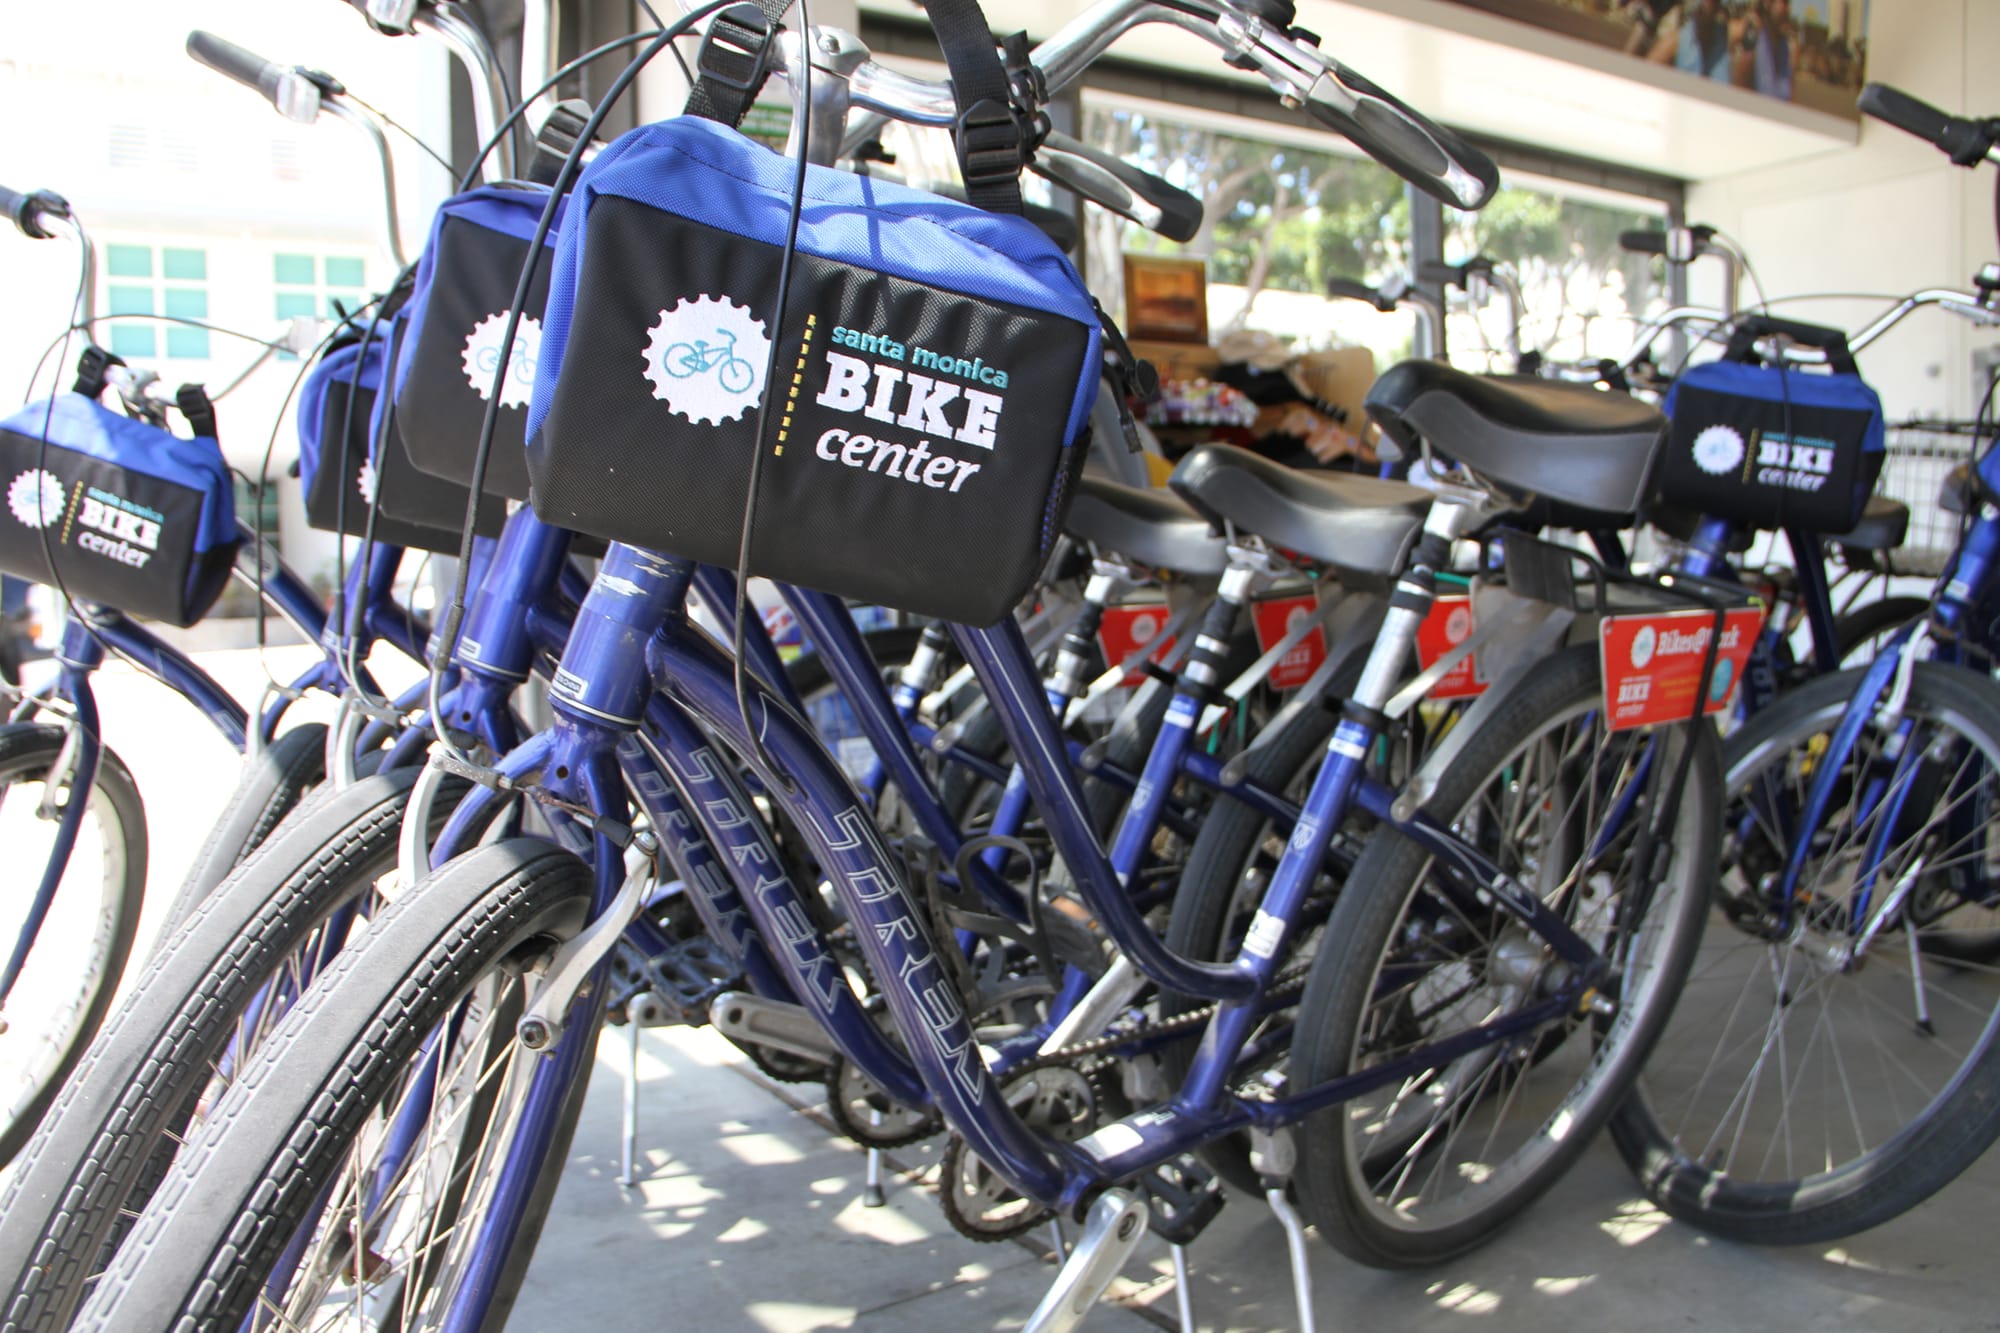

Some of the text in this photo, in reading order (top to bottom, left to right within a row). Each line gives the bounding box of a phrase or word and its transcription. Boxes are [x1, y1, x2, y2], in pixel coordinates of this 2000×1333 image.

[831, 325, 1009, 389] santa monica
[816, 351, 1004, 450] BIKE
[815, 428, 981, 492] center
[1756, 440, 1834, 474] BIKE
[77, 530, 151, 568] center
[78, 496, 162, 550] BIKE
[665, 746, 846, 1014] TREK
[805, 805, 985, 1106] TREK
